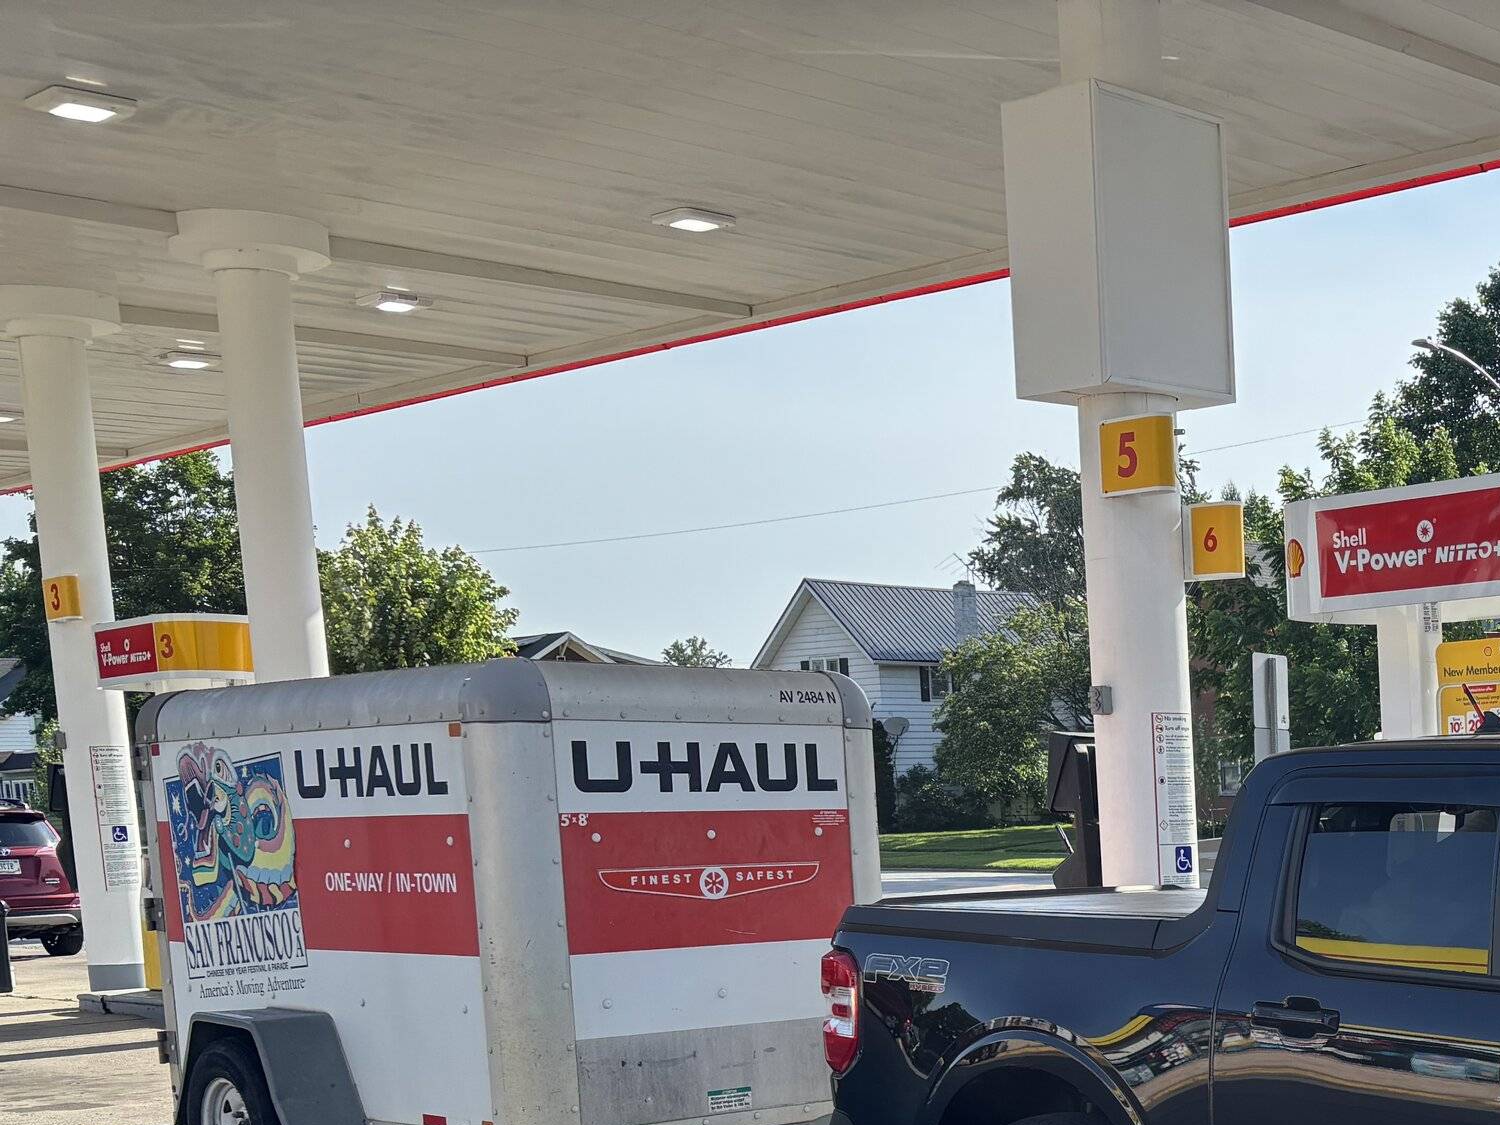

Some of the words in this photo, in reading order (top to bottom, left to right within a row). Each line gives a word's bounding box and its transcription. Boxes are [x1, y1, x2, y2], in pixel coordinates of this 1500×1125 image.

[1117, 431, 1138, 479] 5
[1203, 526, 1218, 552] 6
[1333, 528, 1367, 549] Shell
[50, 583, 61, 611] 3
[100, 641, 112, 653] Shell
[160, 633, 175, 659] 3
[102, 653, 128, 667] V-Power
[1443, 666, 1464, 678] New
[780, 689, 794, 703] AV
[797, 690, 825, 704] 2484
[826, 691, 837, 704] N
[294, 743, 449, 799] U-HAUL
[571, 740, 838, 793] U-HAUL
[325, 871, 384, 892] ONE-WAY
[396, 872, 457, 893] IN-TOWN
[630, 873, 692, 886] FINEST
[735, 869, 794, 882] SAFEST
[185, 922, 214, 970] SAN
[214, 911, 293, 967] FRANCISCO
[206, 969, 225, 978] CHINESE
[225, 968, 235, 976] NEW
[236, 967, 247, 975] YEAR
[247, 964, 266, 974] FESTIVAL
[271, 962, 289, 971] PARADE
[199, 981, 234, 999] America's
[236, 978, 264, 997] Moving
[267, 975, 305, 992] Adventure
